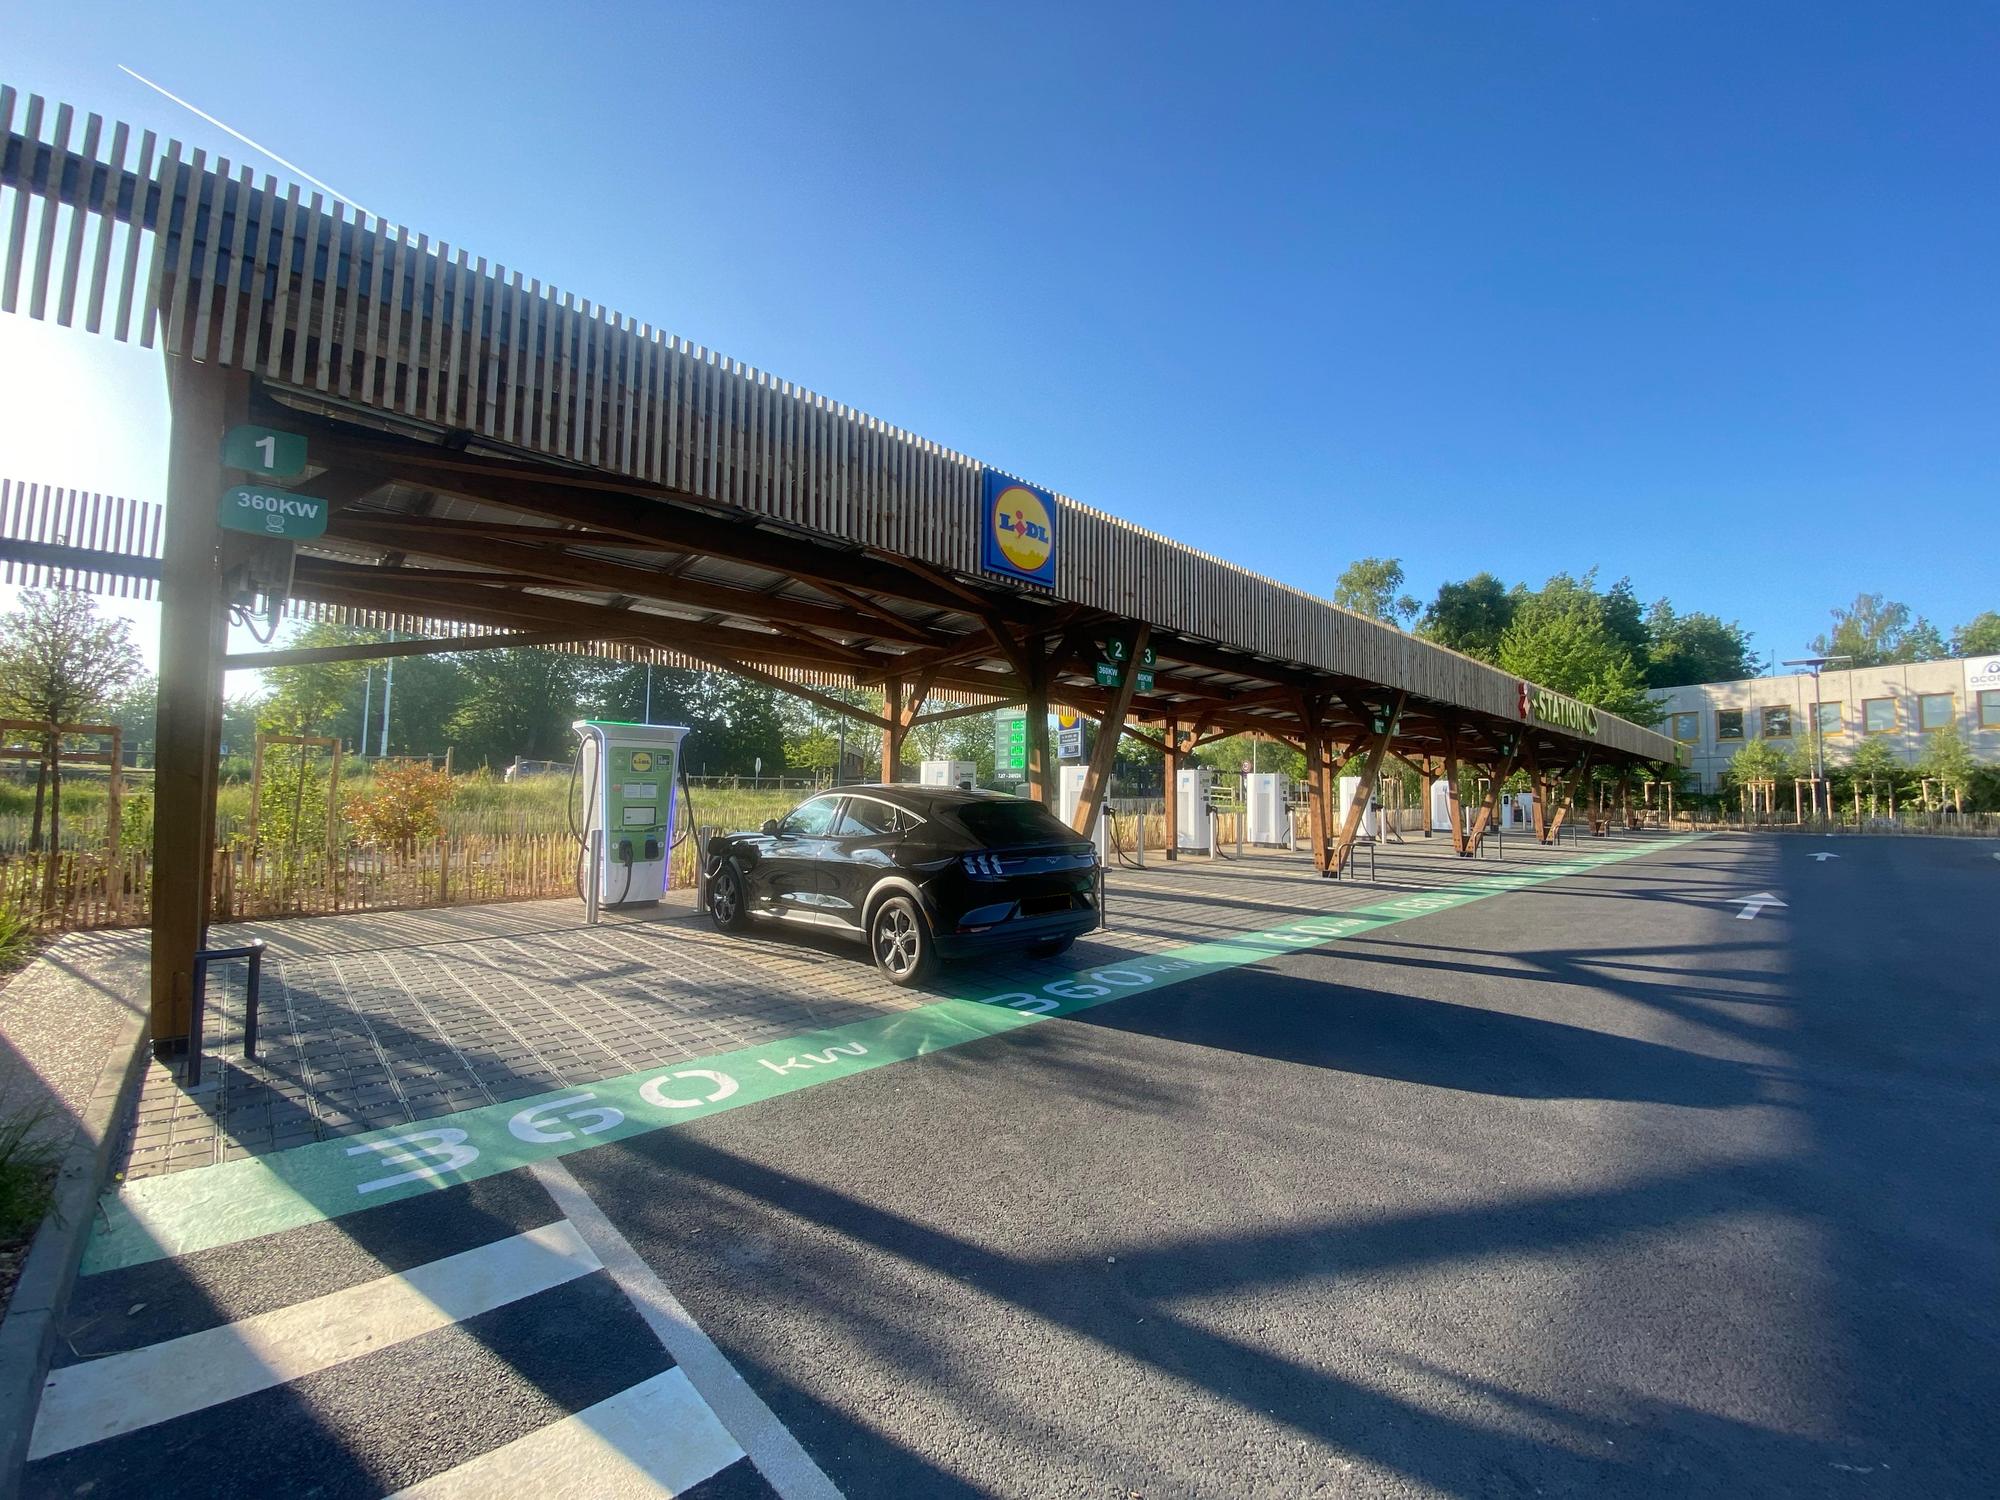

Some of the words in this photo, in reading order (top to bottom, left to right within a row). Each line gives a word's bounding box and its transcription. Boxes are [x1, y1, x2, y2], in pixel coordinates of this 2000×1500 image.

[256, 436, 275, 468] 1
[237, 492, 318, 519] 360KW
[1115, 641, 1122, 657] 2
[1144, 648, 1151, 663] 3
[1538, 690, 1584, 731] STATION
[979, 970, 1154, 1017] 360
[346, 1069, 740, 1194] 360
